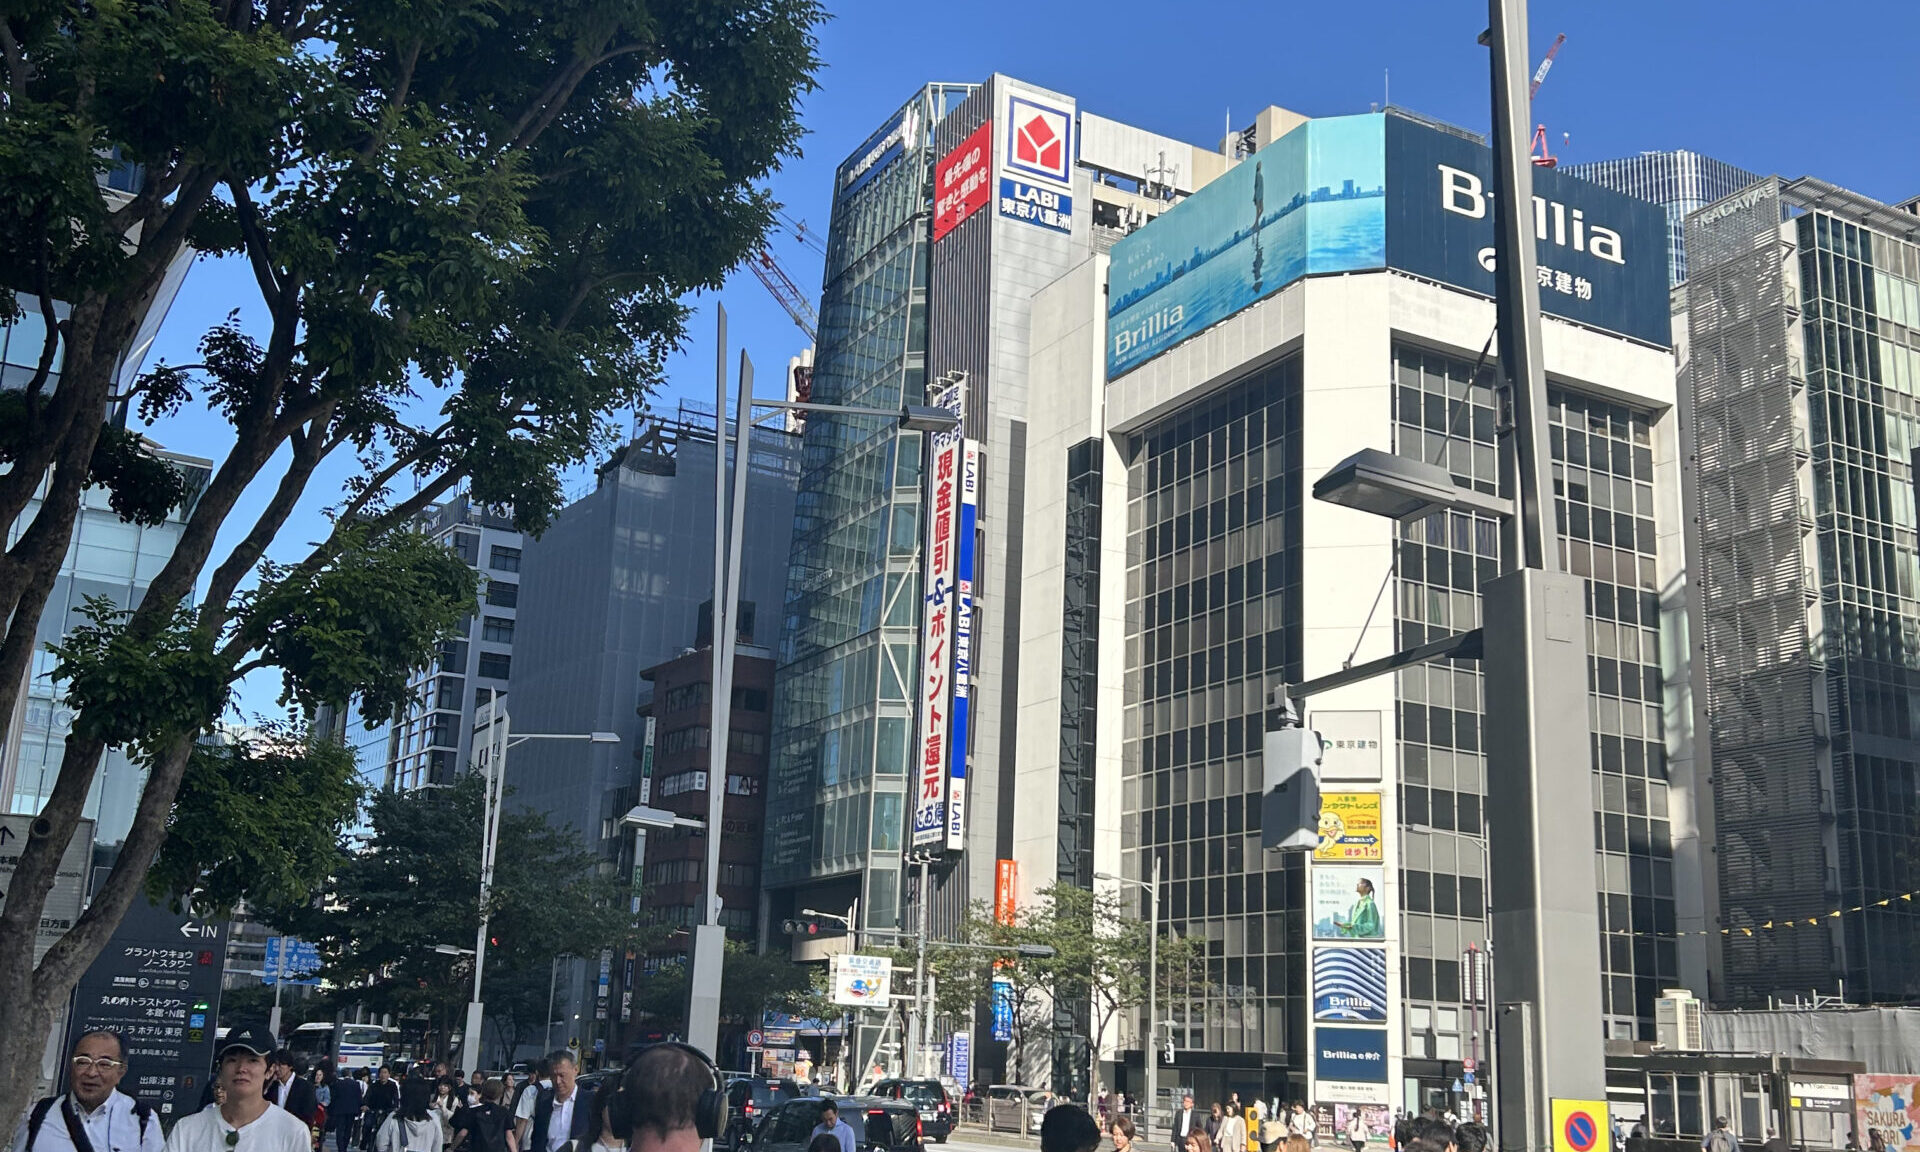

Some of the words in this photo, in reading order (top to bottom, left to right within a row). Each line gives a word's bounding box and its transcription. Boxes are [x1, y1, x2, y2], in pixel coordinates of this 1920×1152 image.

[1014, 183, 1059, 210] LABI
[1001, 197, 1072, 231] 東京八重洲
[1438, 164, 1626, 264] Bllia
[1114, 304, 1184, 357] Brillia
[965, 461, 976, 493] LABI
[1336, 740, 1378, 749] 東京建物
[951, 802, 961, 836] LABI
[200, 925, 217, 938] IN
[124, 947, 194, 959] グラントウキョウ
[143, 959, 193, 968] ノースタワー
[101, 995, 186, 1008] 丸の内トラストタワー
[1329, 996, 1372, 1007] Brillia
[138, 1026, 163, 1035] ホテル
[164, 1027, 183, 1037] 東京
[1867, 1110, 1906, 1127] SAKURA
